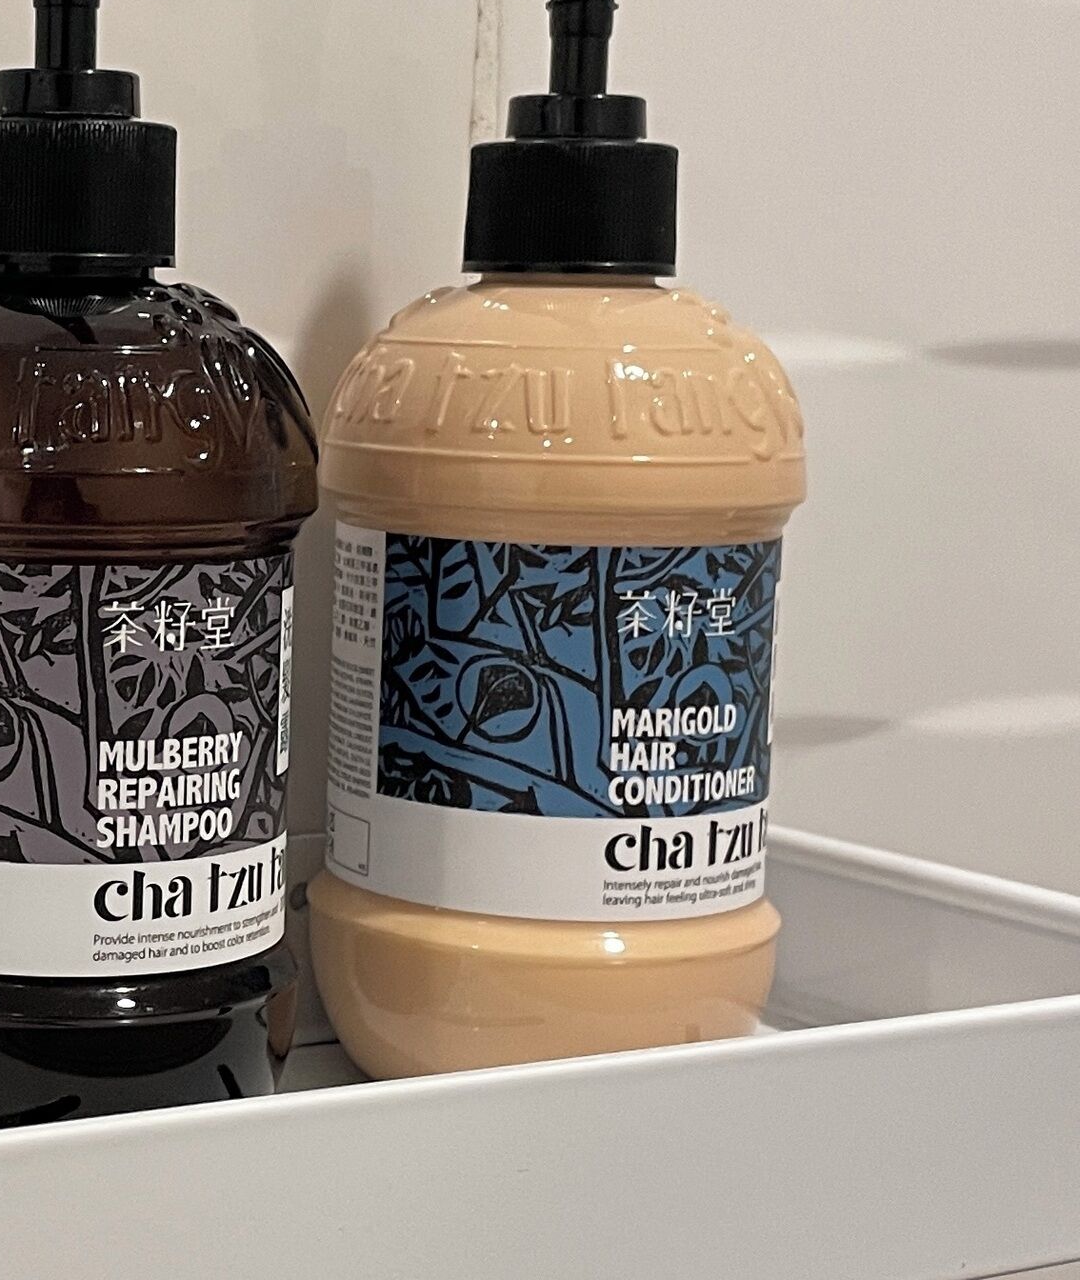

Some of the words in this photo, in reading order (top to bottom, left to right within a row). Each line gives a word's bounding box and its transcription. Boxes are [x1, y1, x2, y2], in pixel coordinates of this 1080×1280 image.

[101, 596, 236, 653] 茶籽堂
[616, 587, 737, 638] 茶籽堂
[611, 703, 737, 738] MARIGOLD
[99, 730, 244, 773] MULBERRY
[610, 742, 678, 772] HAIR
[97, 769, 242, 810] REPAIRING
[607, 765, 756, 807] CONDITIONER
[96, 806, 234, 848] SHAMPOO
[604, 824, 694, 872] cha
[707, 820, 754, 867] tzu
[93, 870, 193, 922] cha
[208, 862, 264, 913] tzu
[602, 891, 643, 908] leaving
[644, 892, 665, 905] hair
[665, 890, 698, 904] feeling
[603, 879, 652, 892] Intensely
[653, 878, 682, 891] repair
[683, 875, 701, 888] and
[93, 933, 136, 946] Provide
[137, 930, 176, 944] intense
[177, 922, 233, 941] nourishment
[93, 946, 146, 964] damaged
[148, 945, 168, 959] hair
[169, 943, 189, 957] and
[190, 943, 201, 954] to
[202, 939, 226, 953] boost
[227, 933, 245, 947] color
